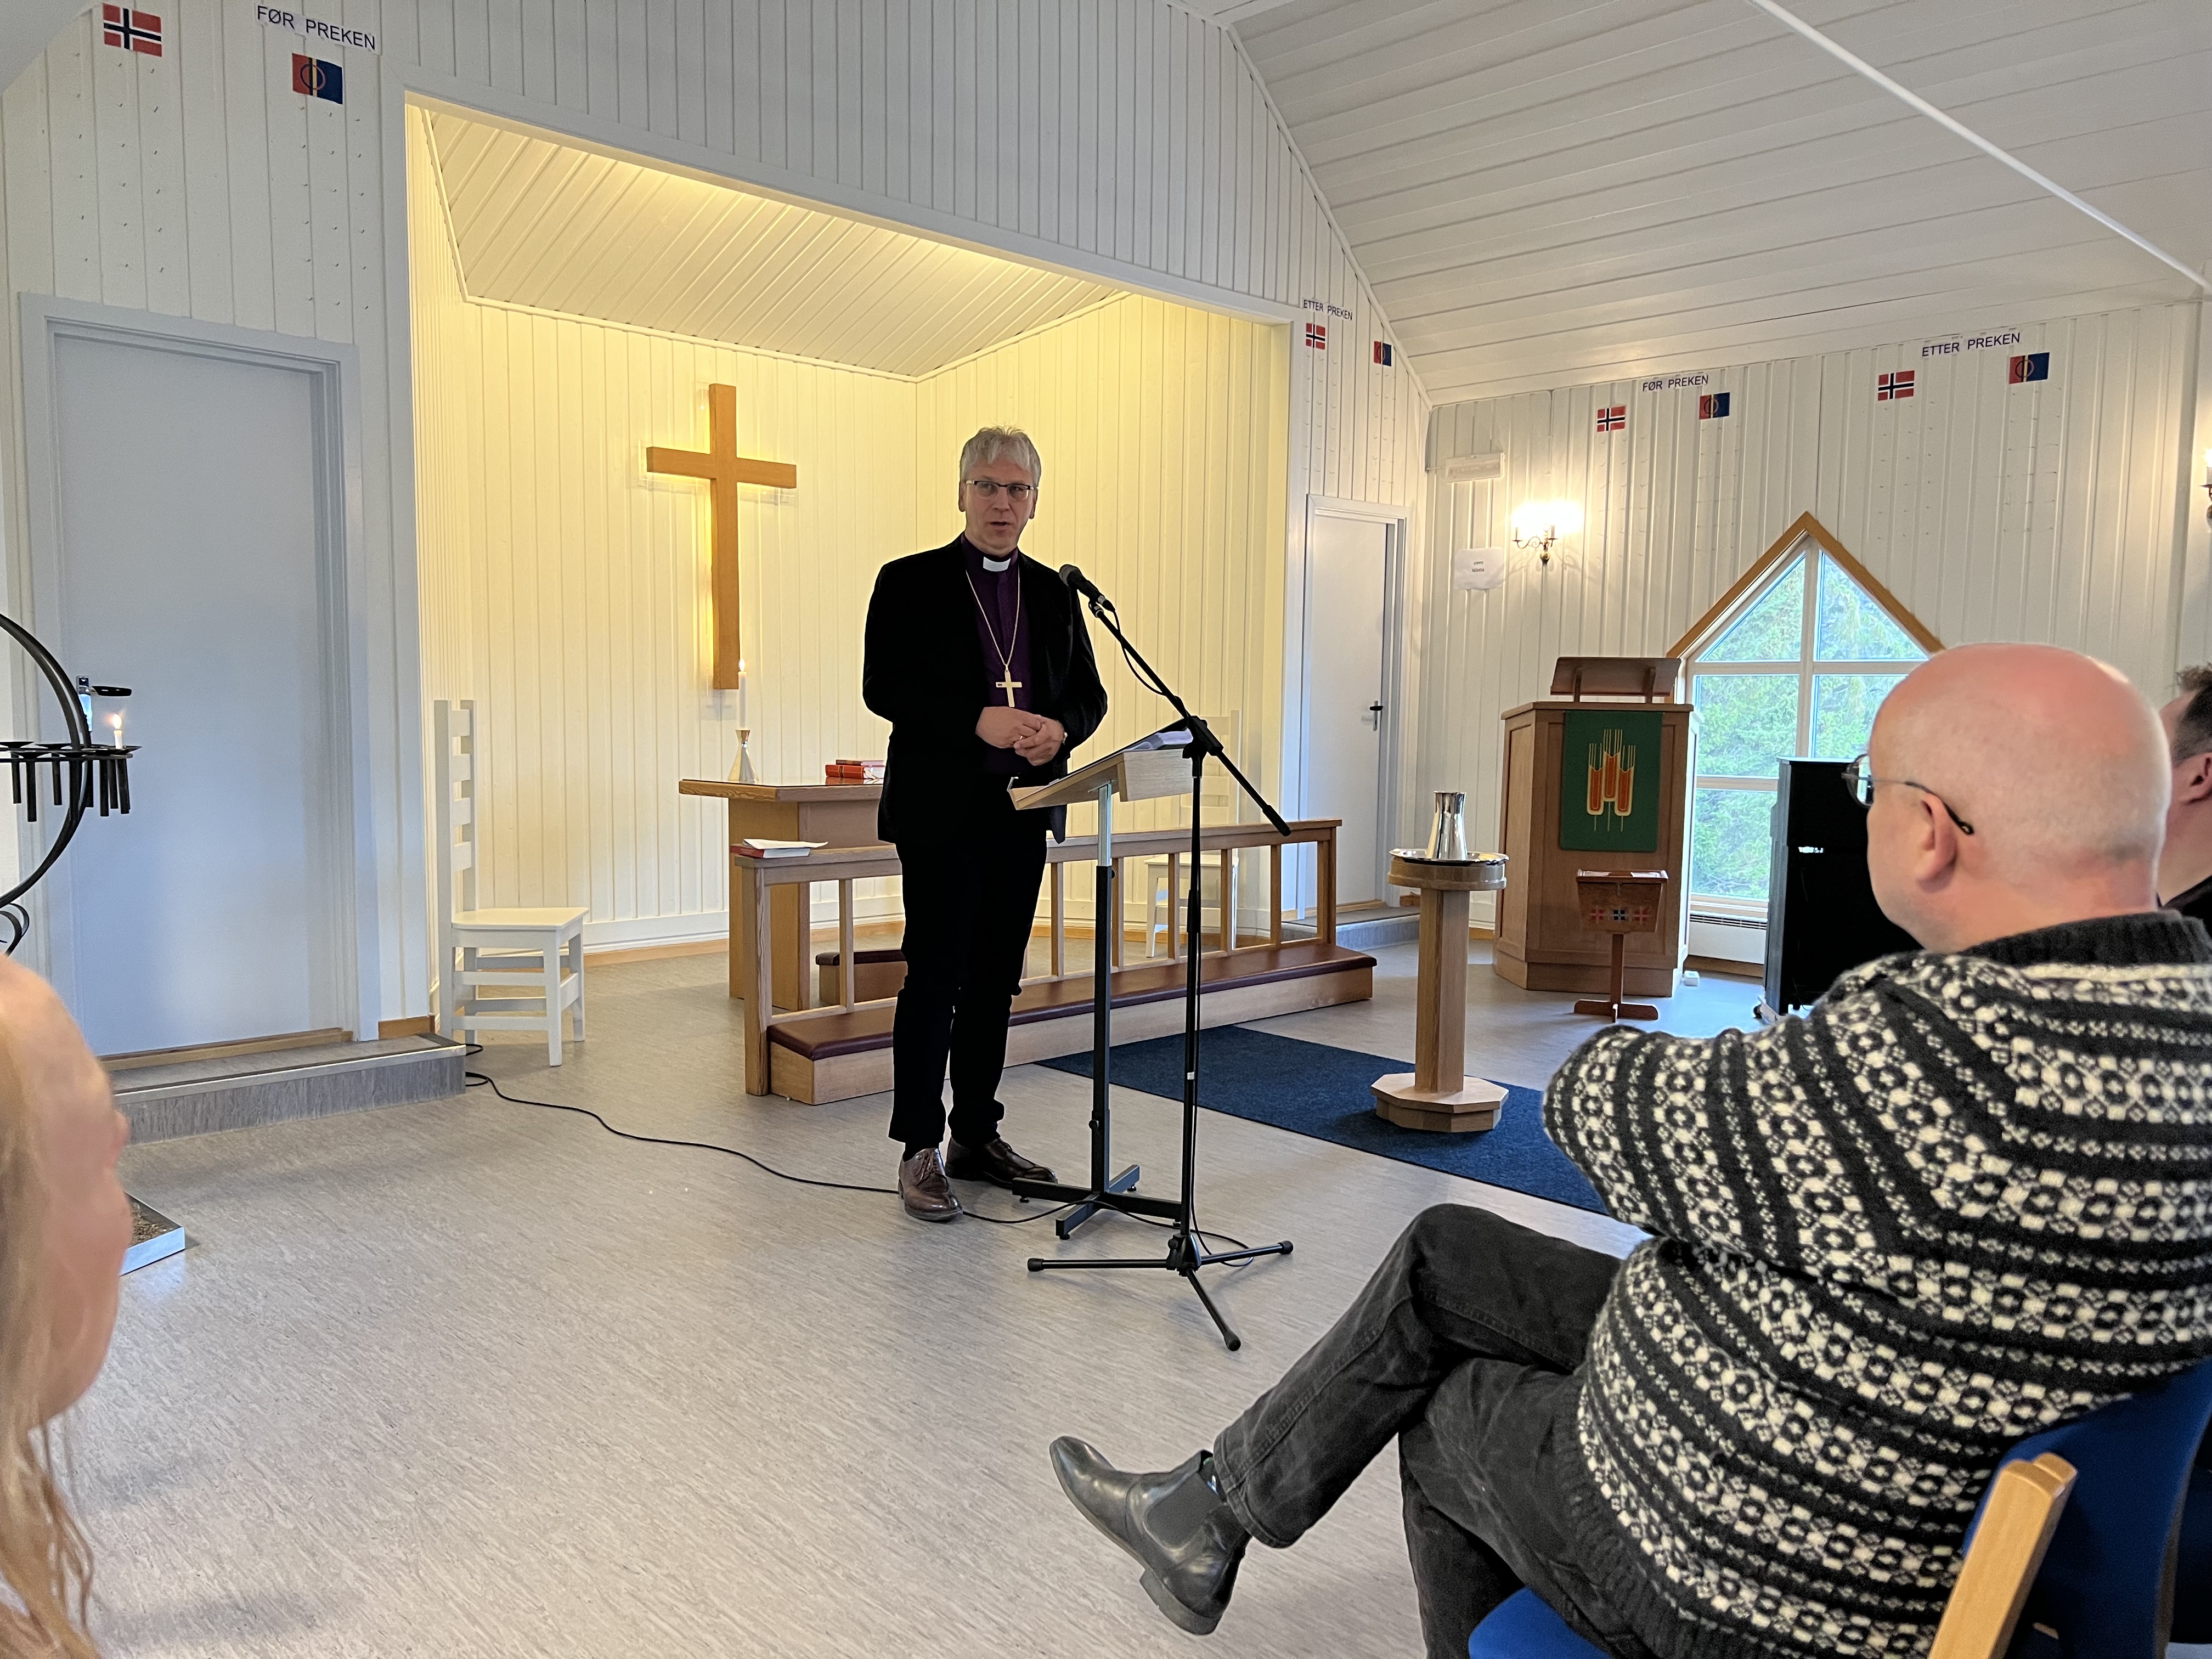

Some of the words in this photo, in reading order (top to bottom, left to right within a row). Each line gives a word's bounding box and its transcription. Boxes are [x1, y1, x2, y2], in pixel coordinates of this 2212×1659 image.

[257, 5, 295, 29] FØR
[306, 19, 375, 50] PREKEN
[1303, 299, 1323, 312] ETTER
[1327, 305, 1353, 320] PREKEN
[1922, 342, 1960, 357] ETTER
[1967, 332, 2021, 350] PREKEN
[1643, 381, 1662, 392] FØR
[1668, 375, 1708, 388] PREKEN
